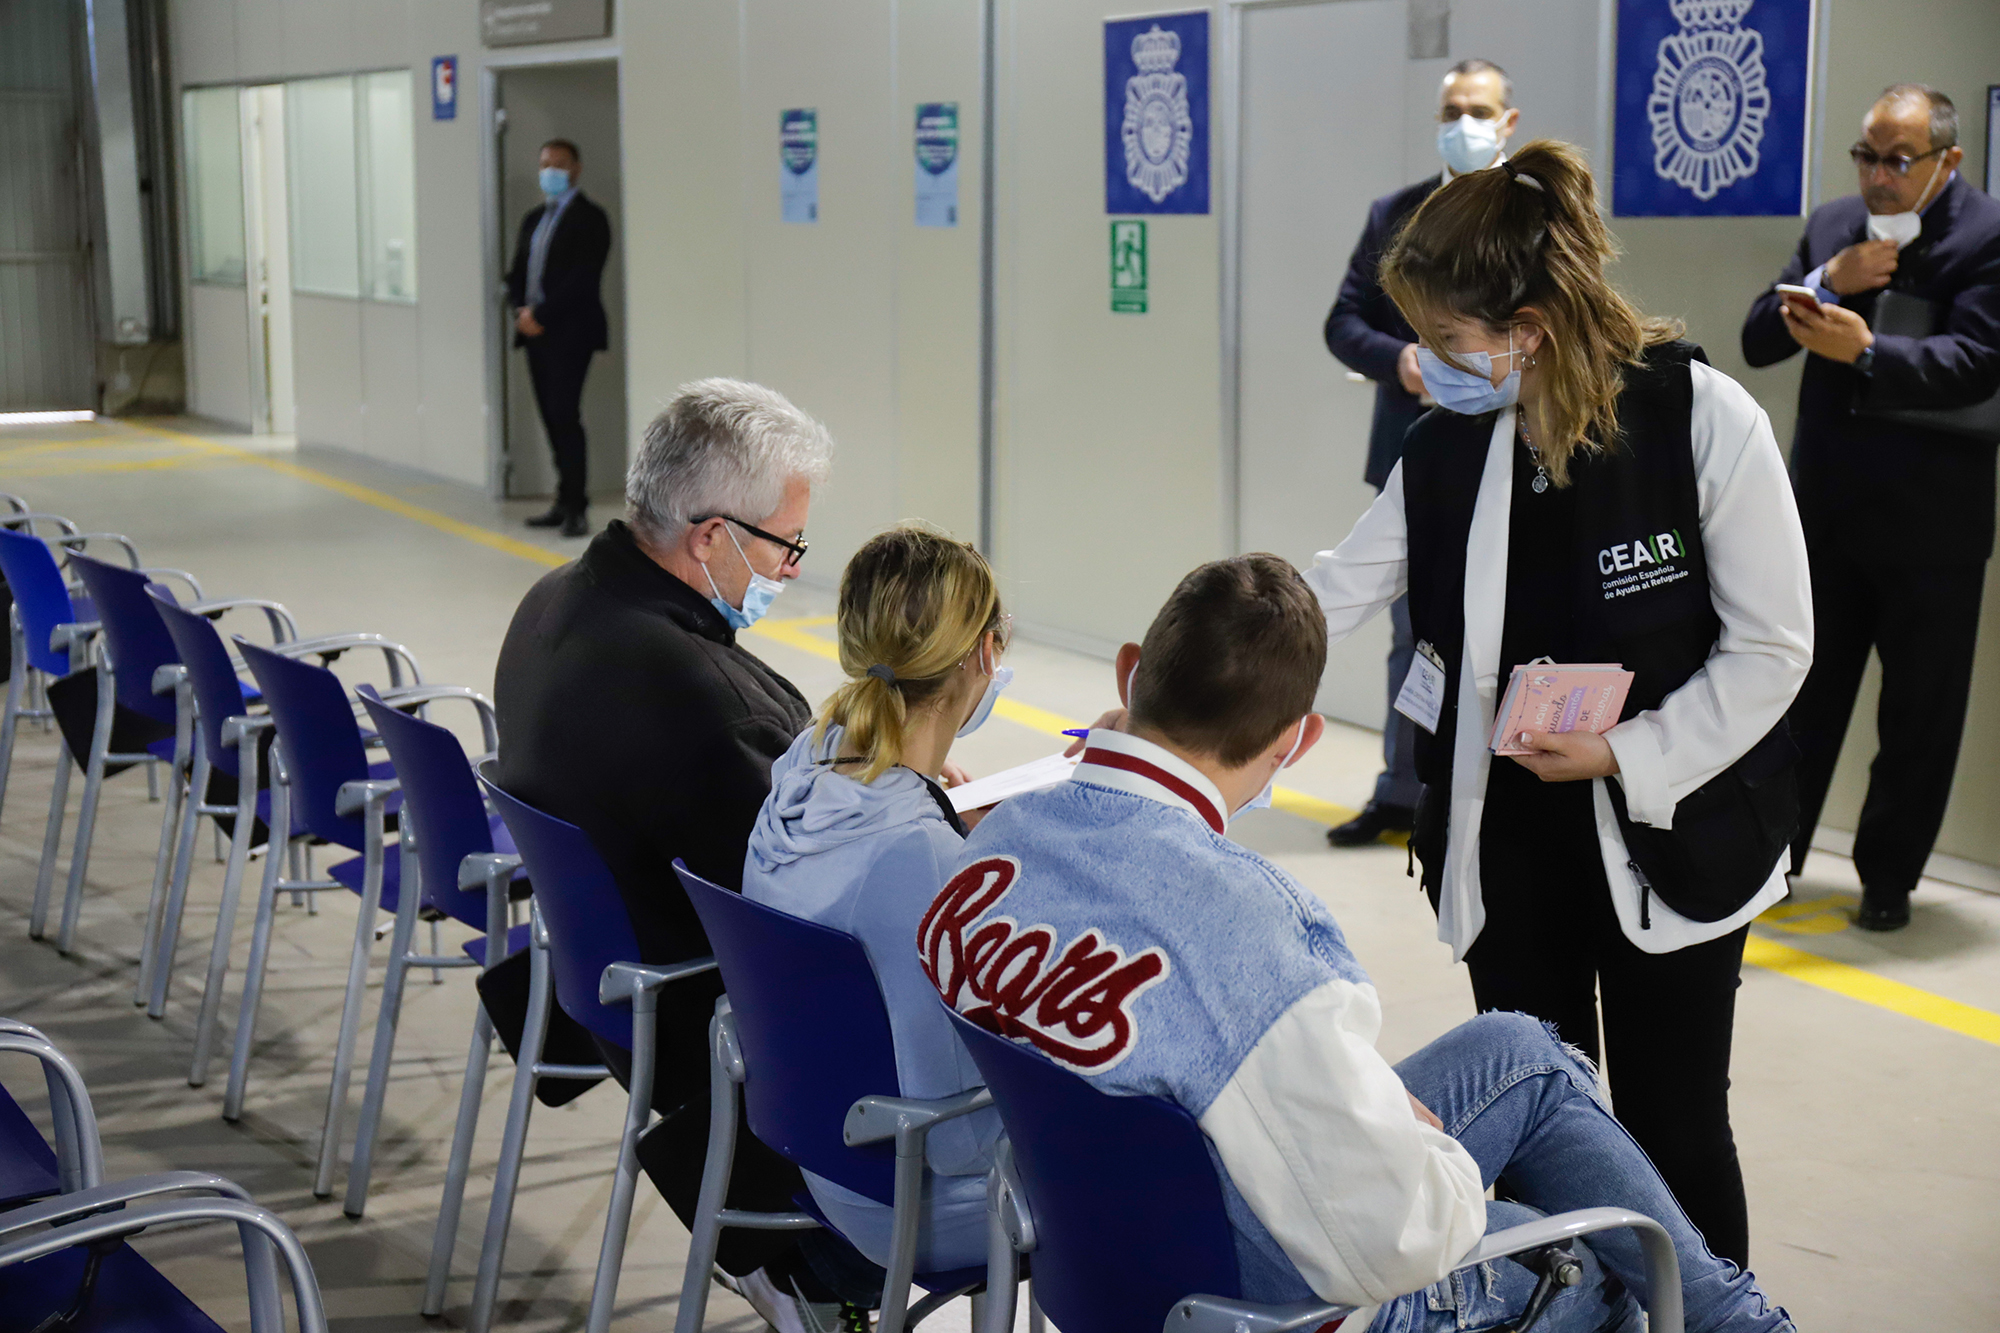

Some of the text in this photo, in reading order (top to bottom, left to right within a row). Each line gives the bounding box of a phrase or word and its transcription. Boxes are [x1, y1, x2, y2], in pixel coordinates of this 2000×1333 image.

[1598, 528, 1686, 575] CEA(R)
[1602, 565, 1675, 590] Comisión Española
[1604, 570, 1689, 600] de Ayuda al Refugiado
[1566, 689, 1583, 726] MONTÓN
[1580, 709, 1591, 722] DE
[917, 857, 1165, 1068] Bears
